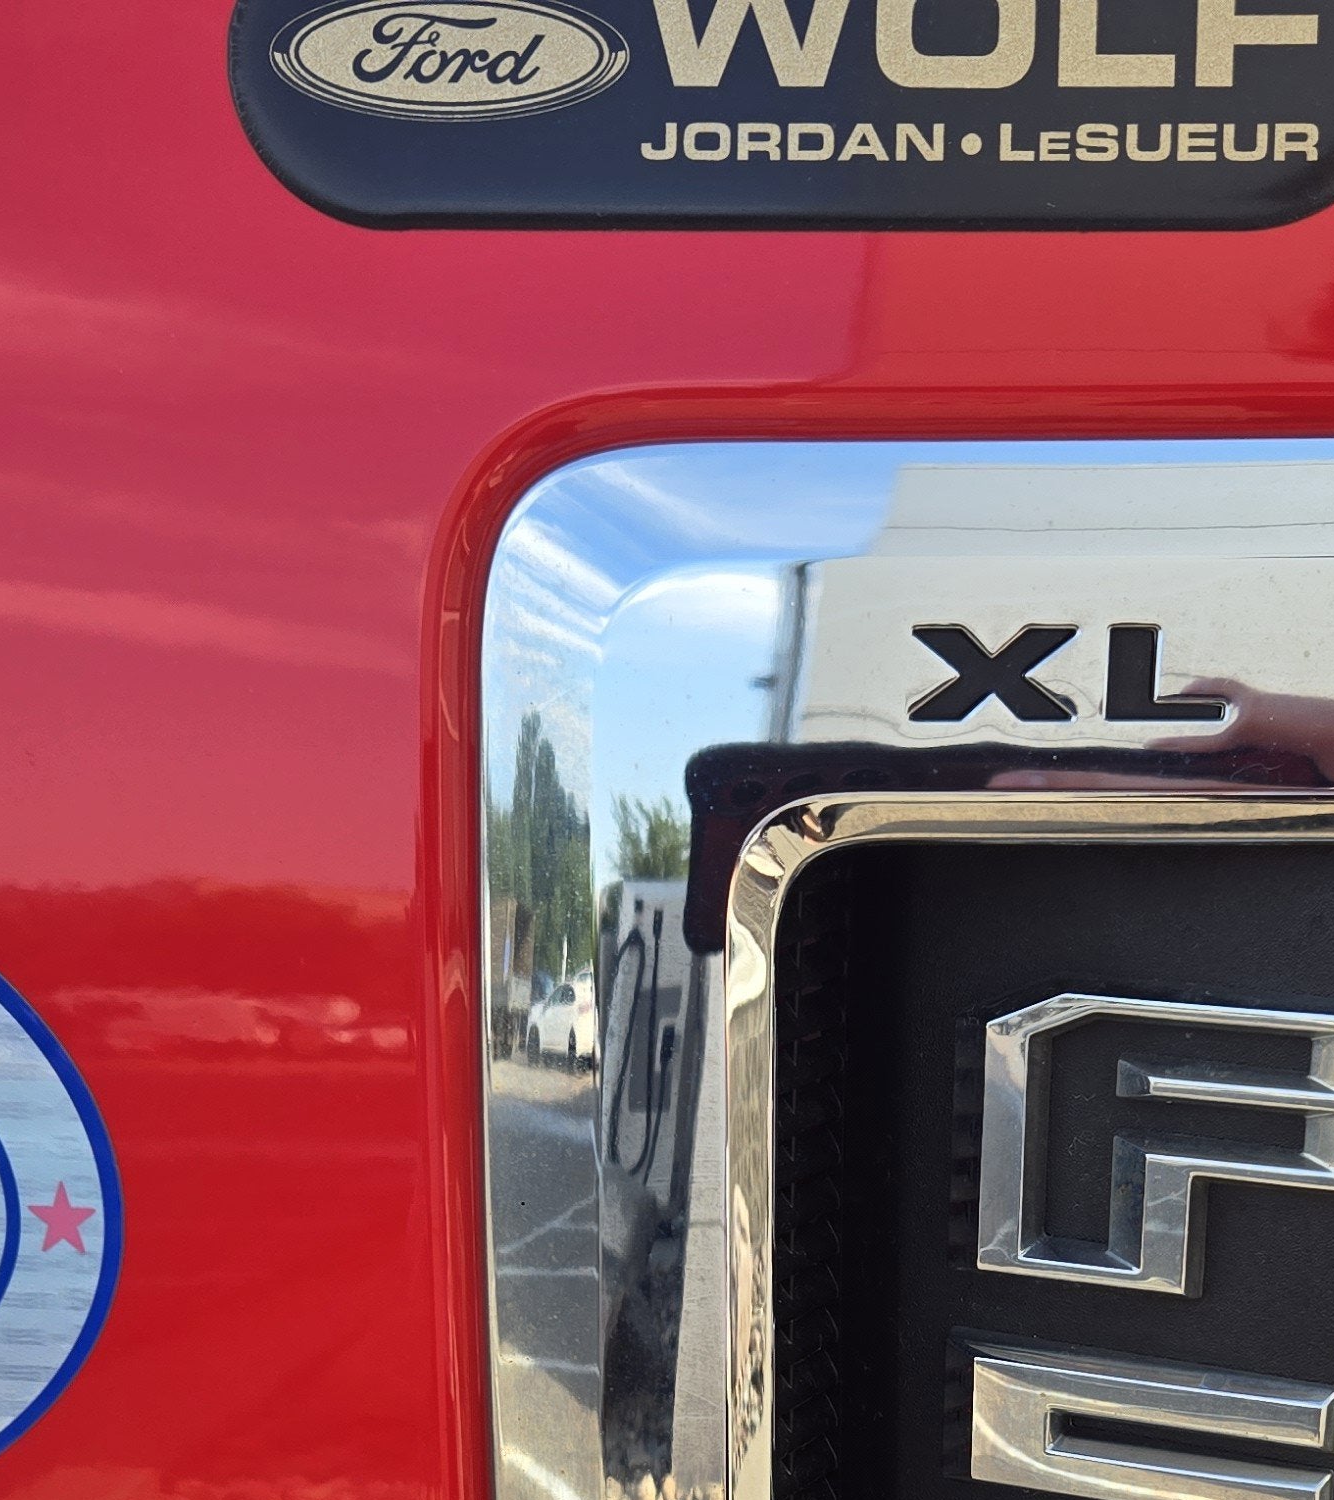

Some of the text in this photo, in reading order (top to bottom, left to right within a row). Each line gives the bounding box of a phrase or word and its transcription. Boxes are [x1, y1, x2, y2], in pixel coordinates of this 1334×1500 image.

[352, 13, 546, 86] Ford
[653, 0, 1320, 89] WOLF
[640, 121, 945, 162] JORDAN
[907, 622, 1227, 723] XL
